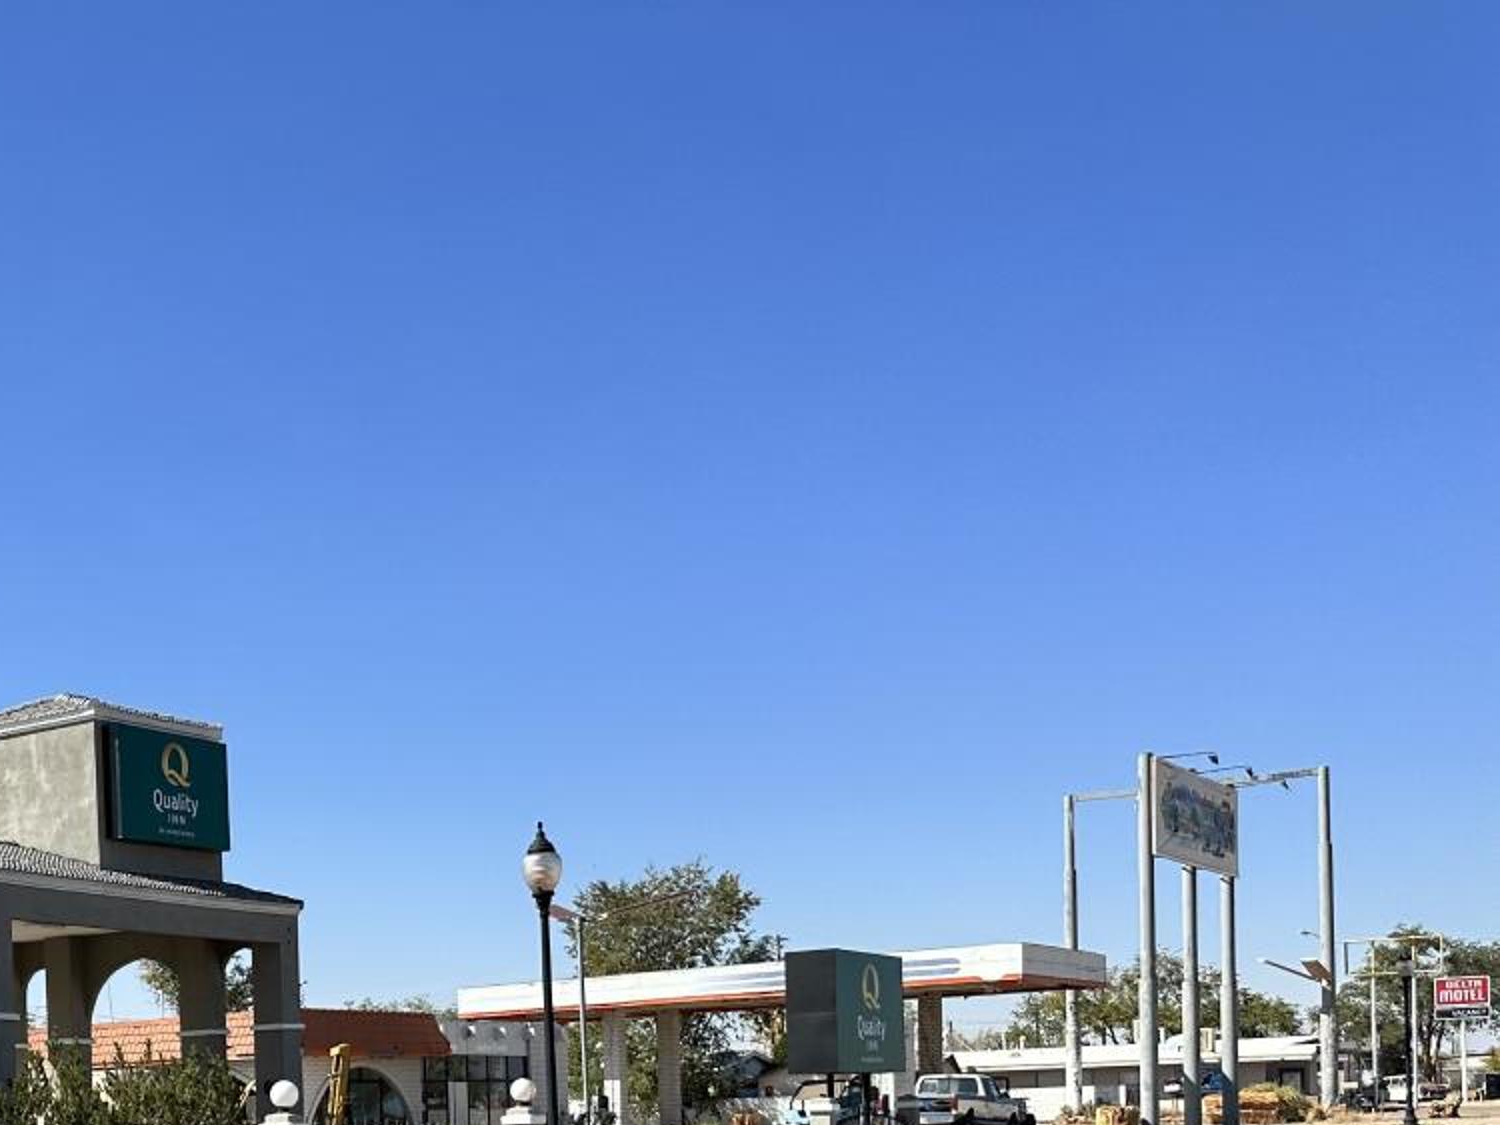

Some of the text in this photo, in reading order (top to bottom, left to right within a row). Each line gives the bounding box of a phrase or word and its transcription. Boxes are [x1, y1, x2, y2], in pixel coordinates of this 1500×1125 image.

[161, 742, 191, 788] Q
[153, 788, 199, 818] Quality
[862, 963, 881, 1009] Q
[1439, 989, 1486, 1003] MOTEL
[857, 1014, 885, 1041] Quality
